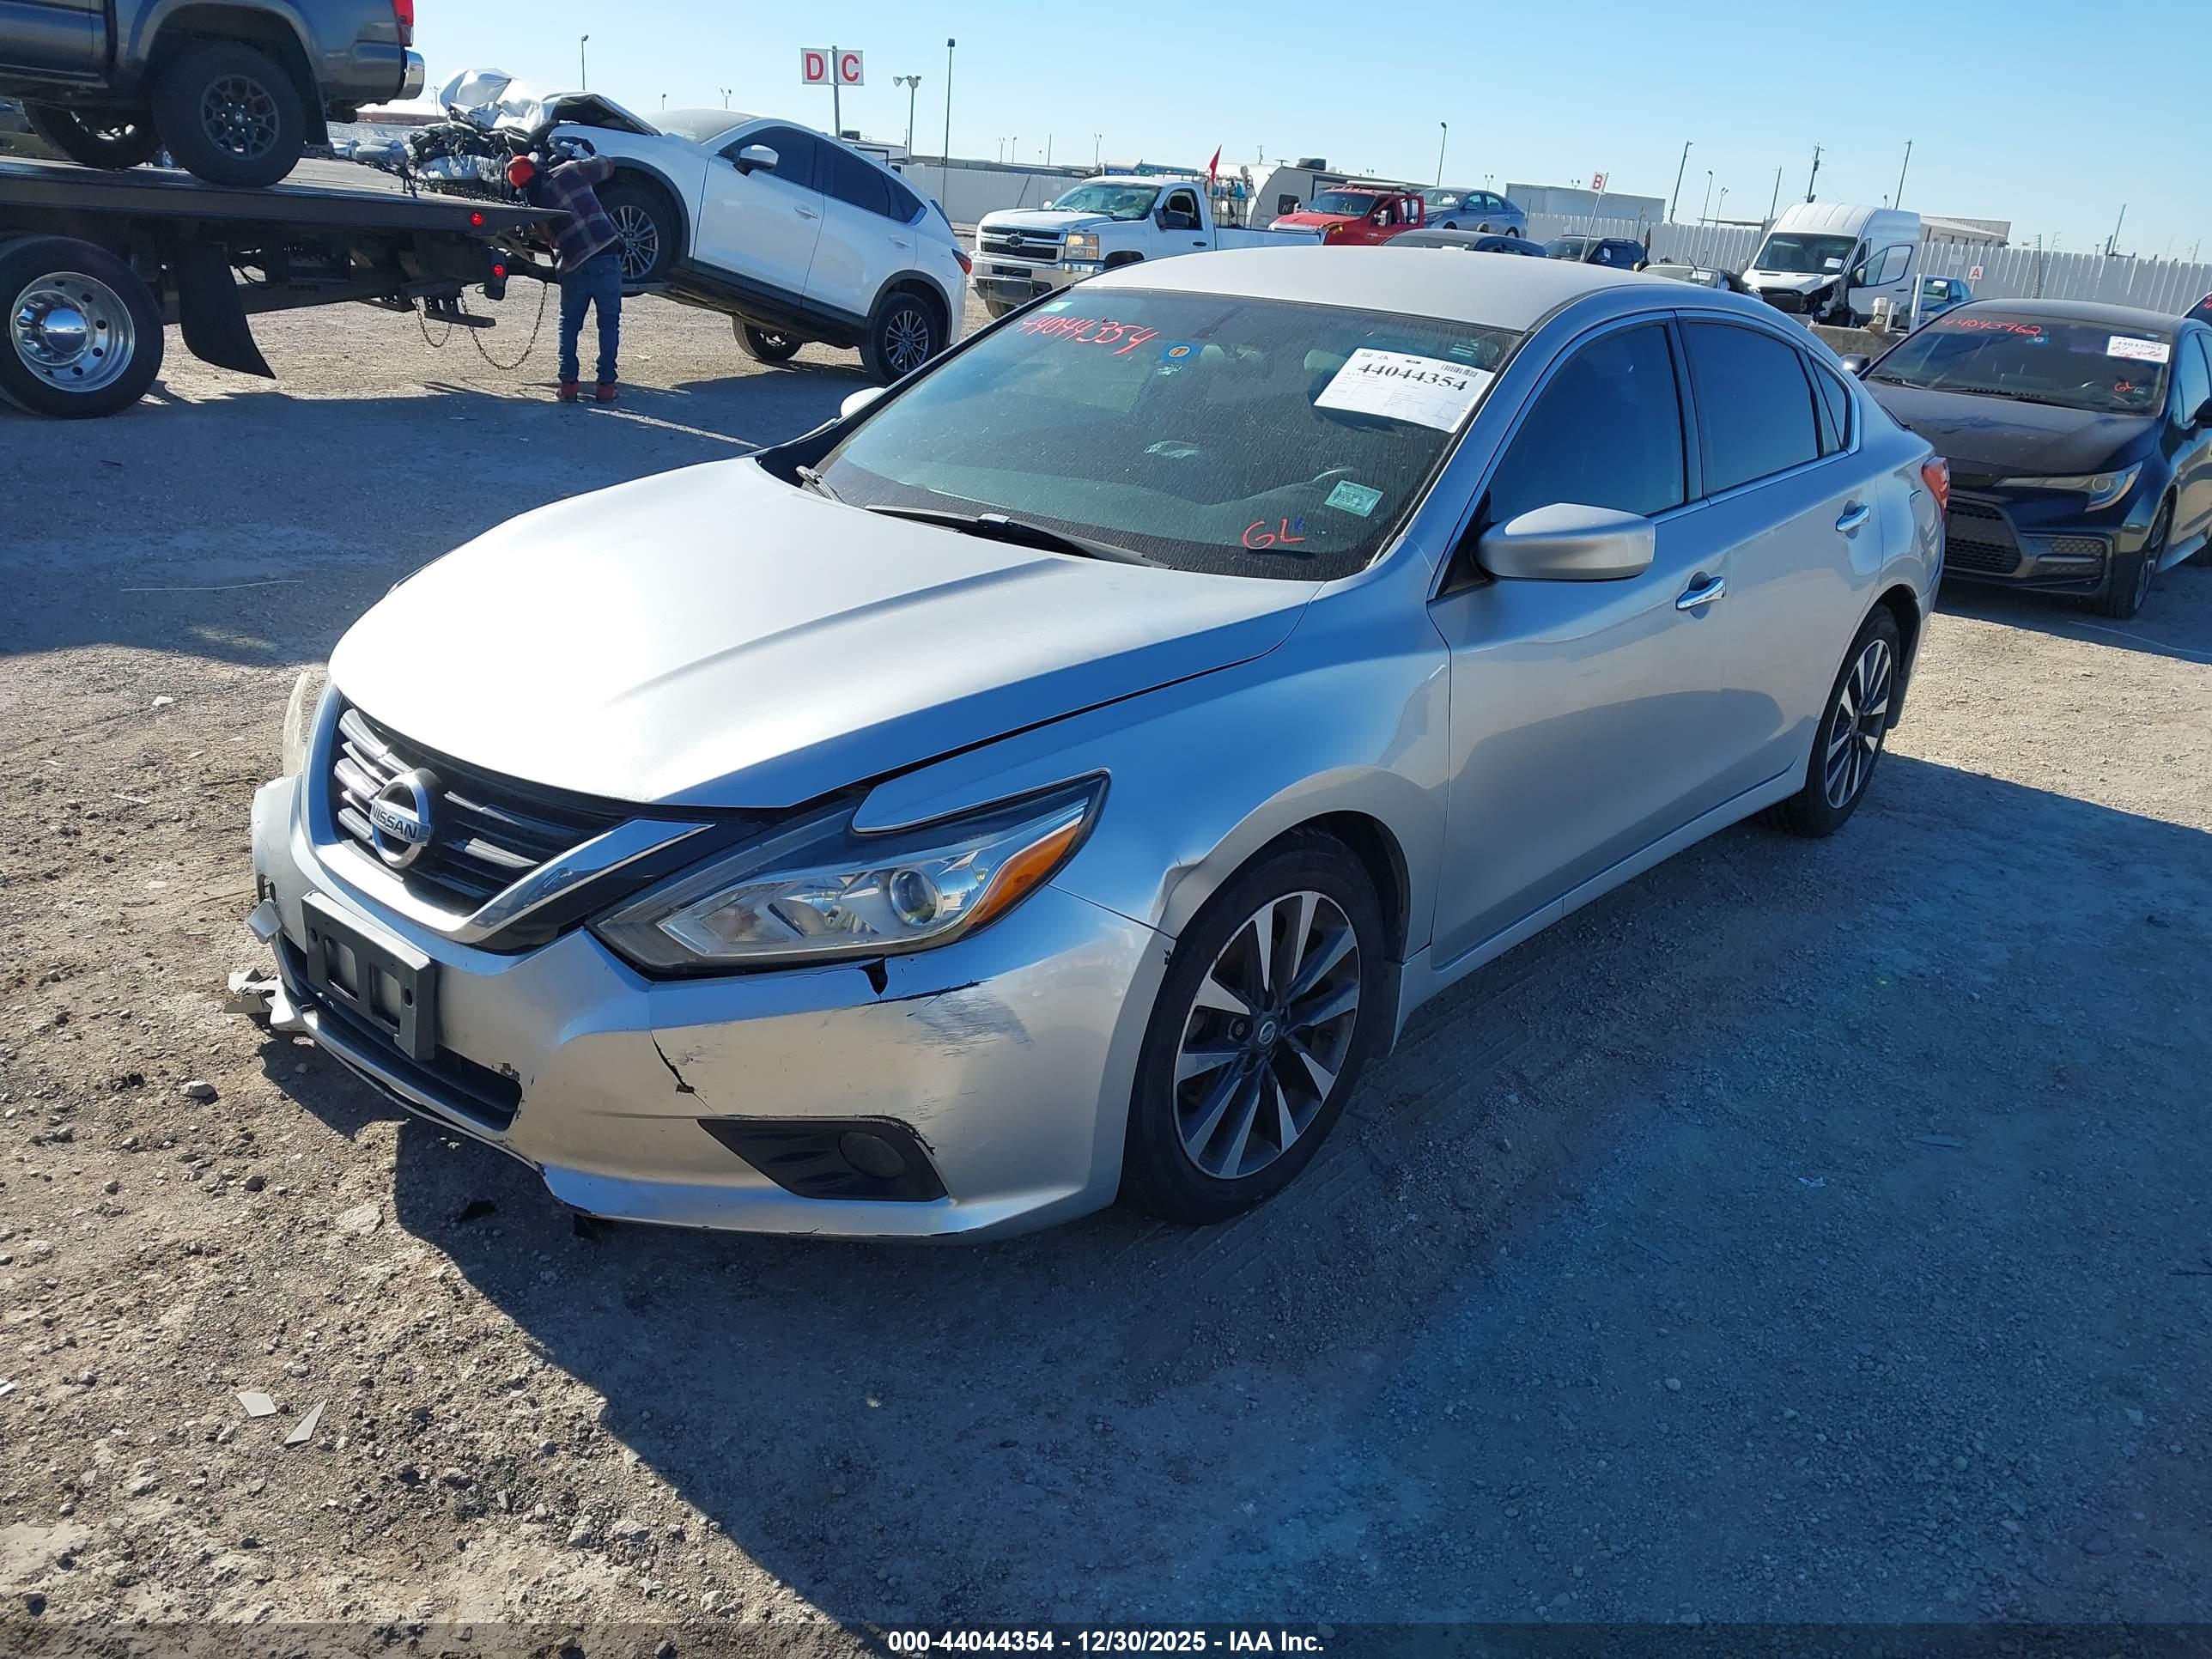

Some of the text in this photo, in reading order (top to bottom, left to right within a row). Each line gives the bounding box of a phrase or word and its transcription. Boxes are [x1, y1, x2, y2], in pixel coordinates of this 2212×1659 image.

[806, 53, 824, 80] D
[842, 54, 859, 82] C
[1593, 174, 1602, 189] B
[1971, 267, 1980, 277] A
[1357, 363, 1468, 391] 44044354
[372, 804, 417, 838] NISSAN
